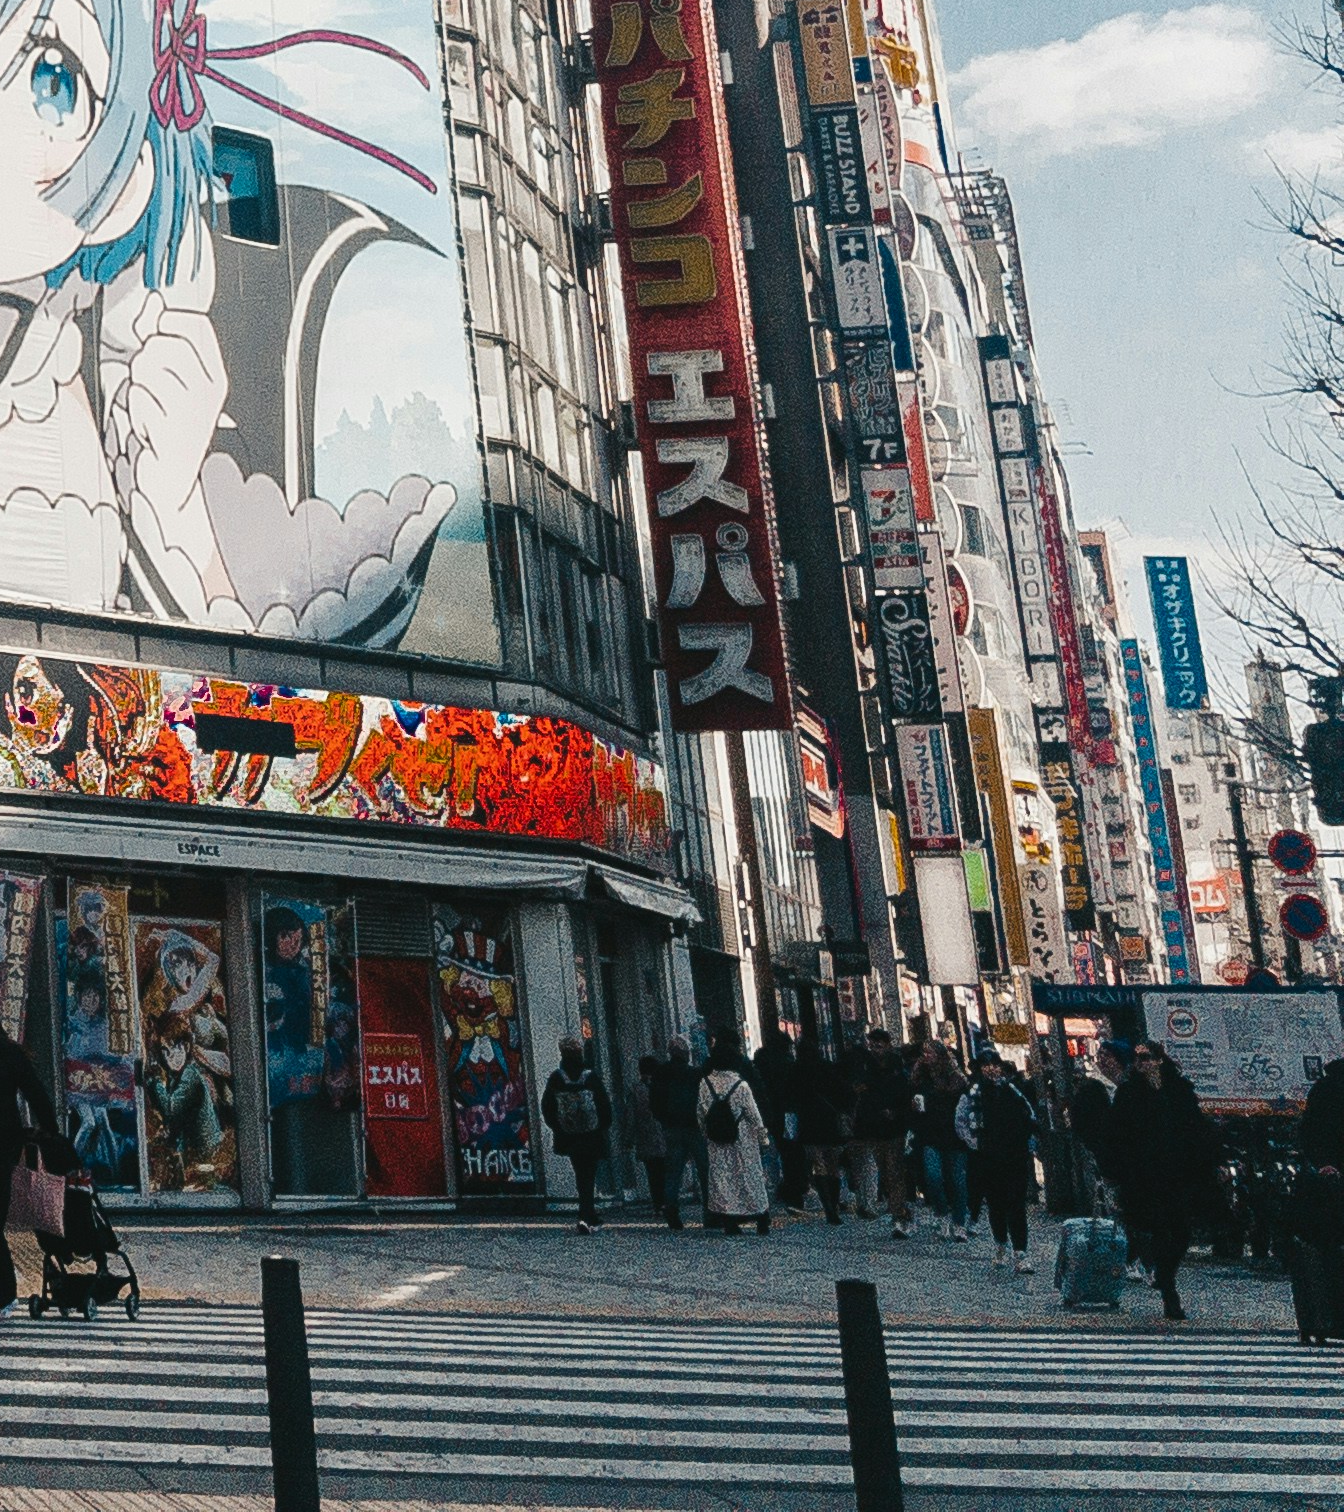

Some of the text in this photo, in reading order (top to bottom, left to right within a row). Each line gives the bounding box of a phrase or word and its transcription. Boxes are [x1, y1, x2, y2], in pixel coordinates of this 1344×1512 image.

[832, 114, 861, 215] BUZZ STAND
[862, 438, 898, 461] 7F
[645, 348, 773, 706] エスパス
[1012, 507, 1045, 652] KIBORI
[881, 597, 928, 711] Sparkle
[177, 842, 221, 858] ESPACE
[368, 1060, 423, 1086] エスパス
